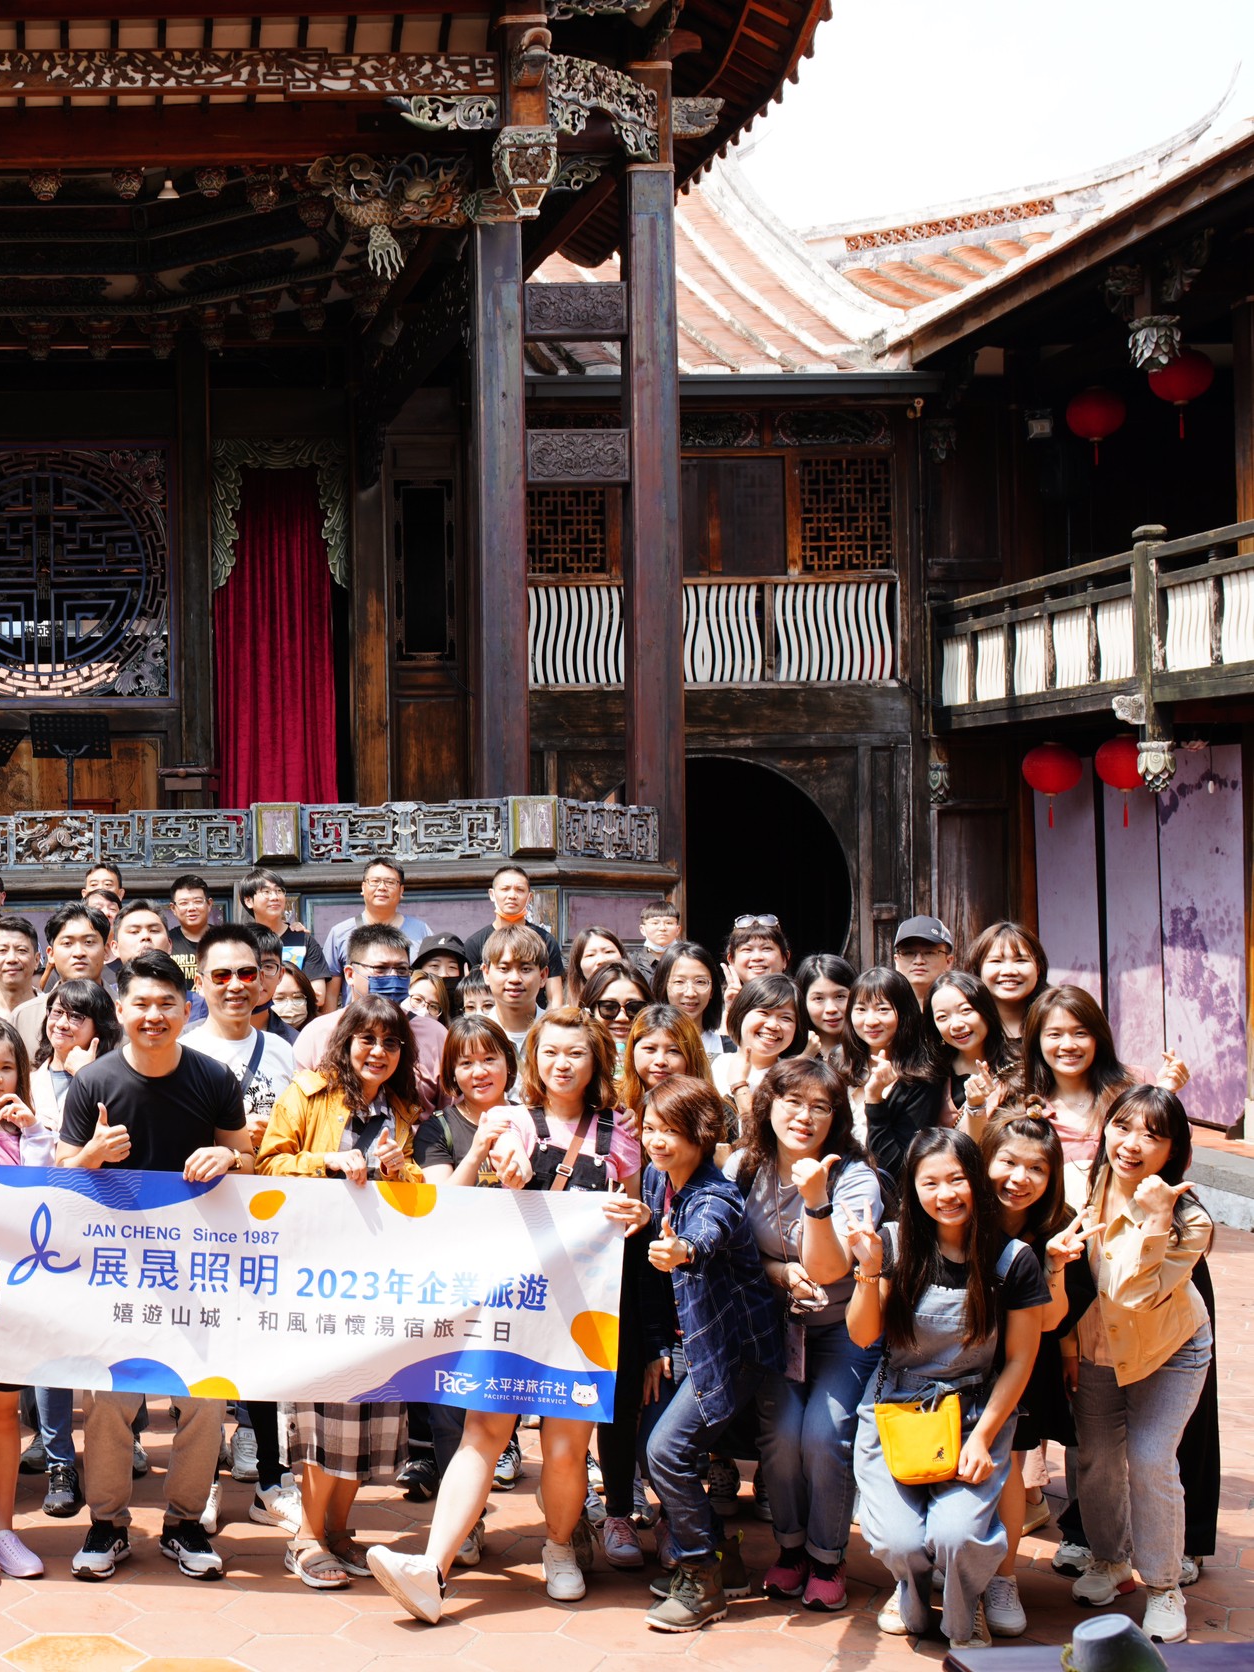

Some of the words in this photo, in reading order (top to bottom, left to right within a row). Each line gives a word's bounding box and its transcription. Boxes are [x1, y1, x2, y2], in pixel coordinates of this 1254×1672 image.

[83, 1224, 116, 1238] JAN
[121, 1225, 181, 1240] CHENG
[193, 1228, 237, 1243] Since
[243, 1231, 279, 1244] 1987
[88, 1247, 279, 1296] 展晟照明
[296, 1266, 548, 1311] 2023年企業旅遊
[485, 1377, 567, 1397] 太平洋旅行社
